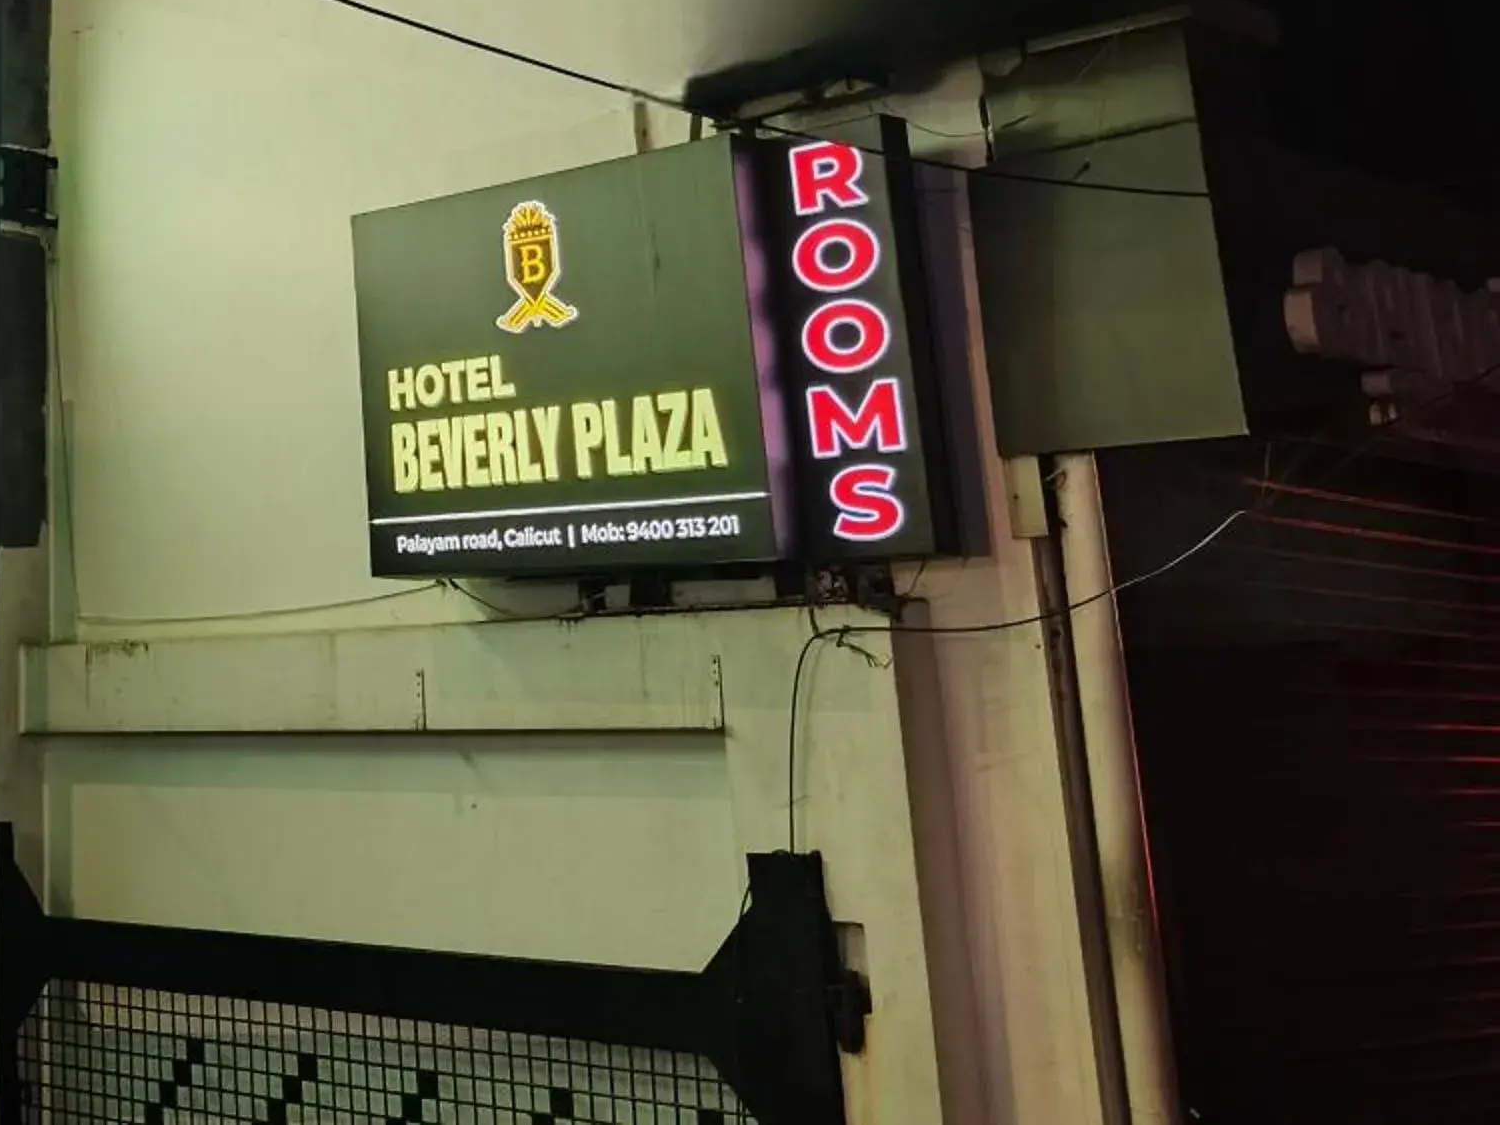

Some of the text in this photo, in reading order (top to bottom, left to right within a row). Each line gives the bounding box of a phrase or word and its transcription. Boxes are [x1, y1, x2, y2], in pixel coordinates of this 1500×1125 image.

[520, 243, 546, 284] B
[789, 139, 908, 541] ROOMS
[387, 354, 517, 412] HOTEL
[391, 387, 729, 494] BEVERLY PLAZA
[396, 514, 741, 556] Palayam road, Calicut Mob: 9400 313 201
